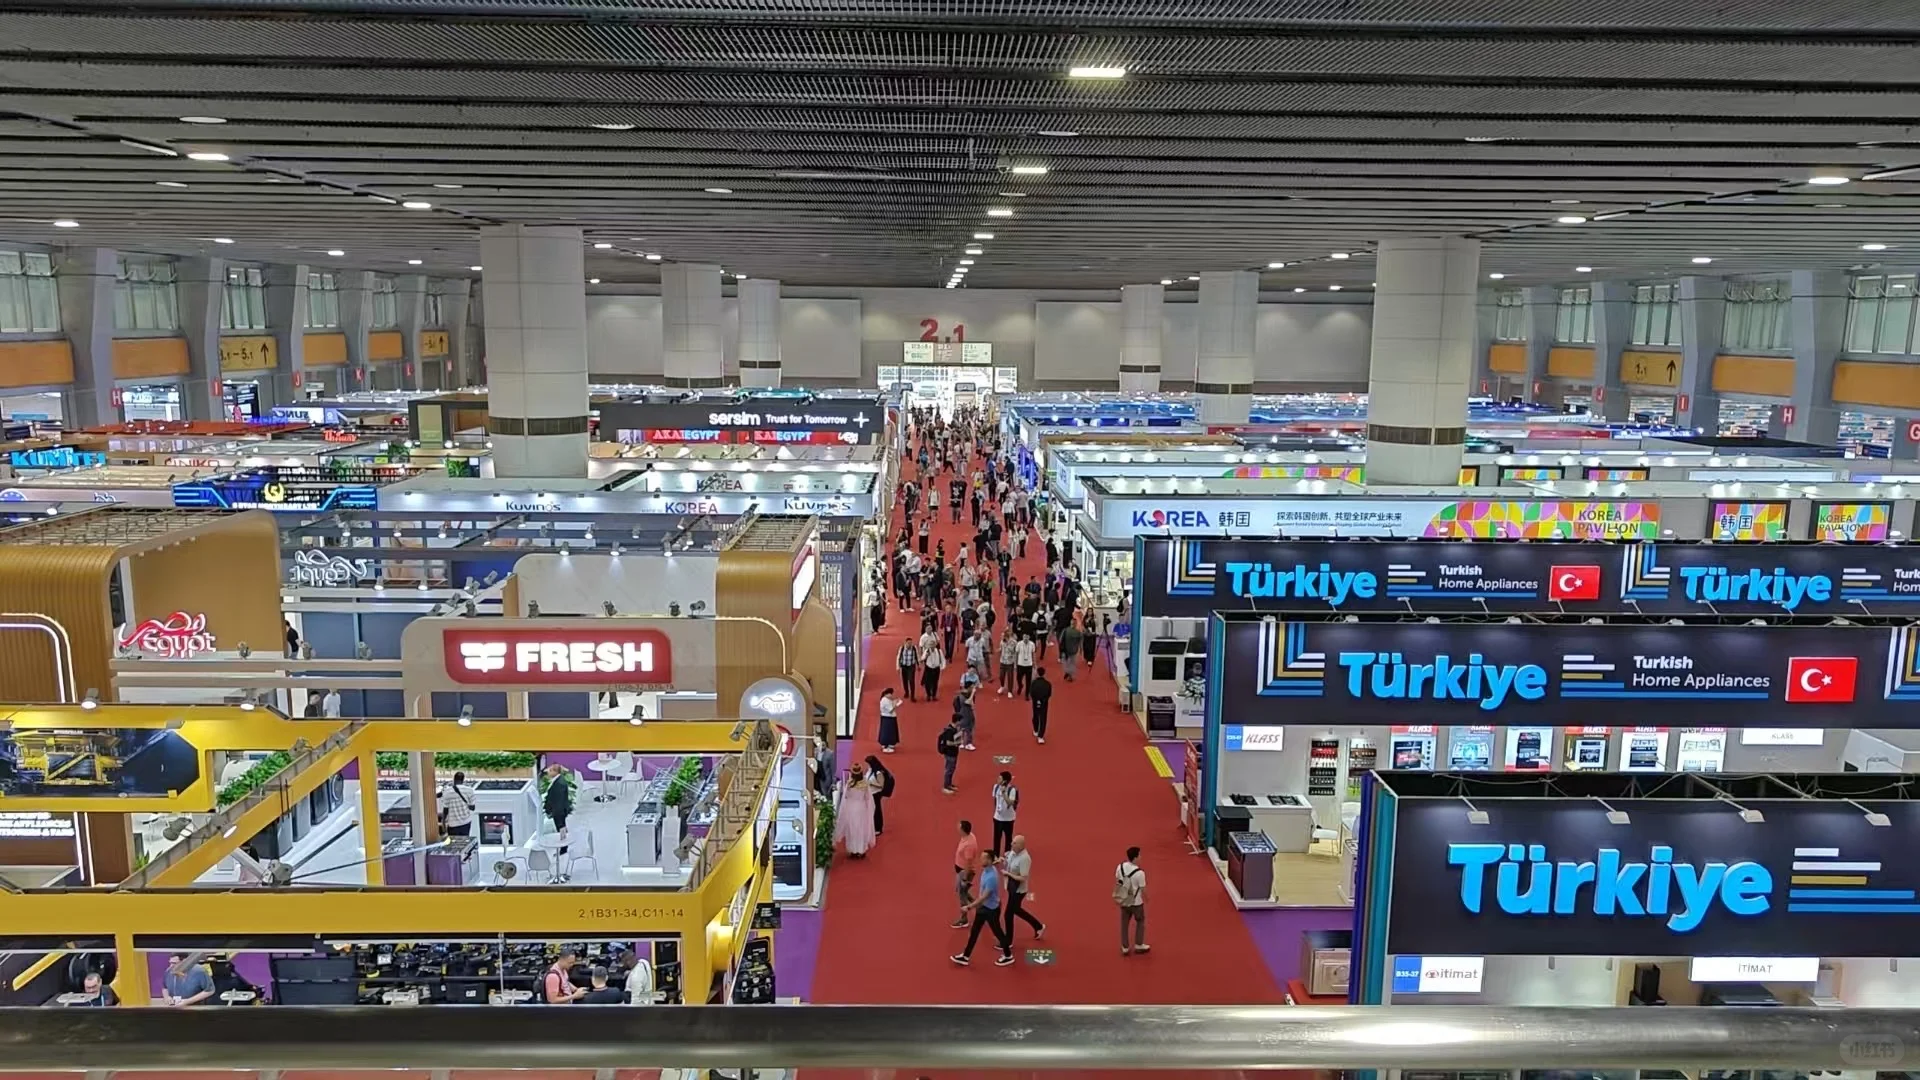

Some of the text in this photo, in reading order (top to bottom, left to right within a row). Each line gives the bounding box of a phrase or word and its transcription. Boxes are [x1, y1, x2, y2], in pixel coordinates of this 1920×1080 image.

[920, 319, 964, 342] 2.1
[113, 390, 122, 405] H
[709, 411, 760, 425] sersim
[766, 414, 791, 423] Trust
[805, 414, 847, 423] Tomorrow
[1783, 407, 1792, 422] H
[665, 502, 718, 514] KOREA
[1579, 510, 1622, 521] KOREA
[1132, 511, 1210, 527] KOREA
[1219, 511, 1250, 527] 韩国
[1720, 514, 1753, 530] 韩国
[1820, 514, 1853, 524] KOREA
[1439, 565, 1482, 575] Turkish
[1226, 562, 1377, 605] Türkiye
[1439, 578, 1538, 590] Home Appliances
[1680, 567, 1832, 609] Türkiye
[516, 642, 653, 672] FRESH
[1633, 656, 1693, 669] Turkish
[1339, 653, 1547, 710] Türkiye
[1633, 674, 1770, 690] Home Appliances
[1245, 734, 1280, 743] KLASS
[1448, 844, 1774, 932] Türkiye
[1440, 969, 1478, 978] itimat
